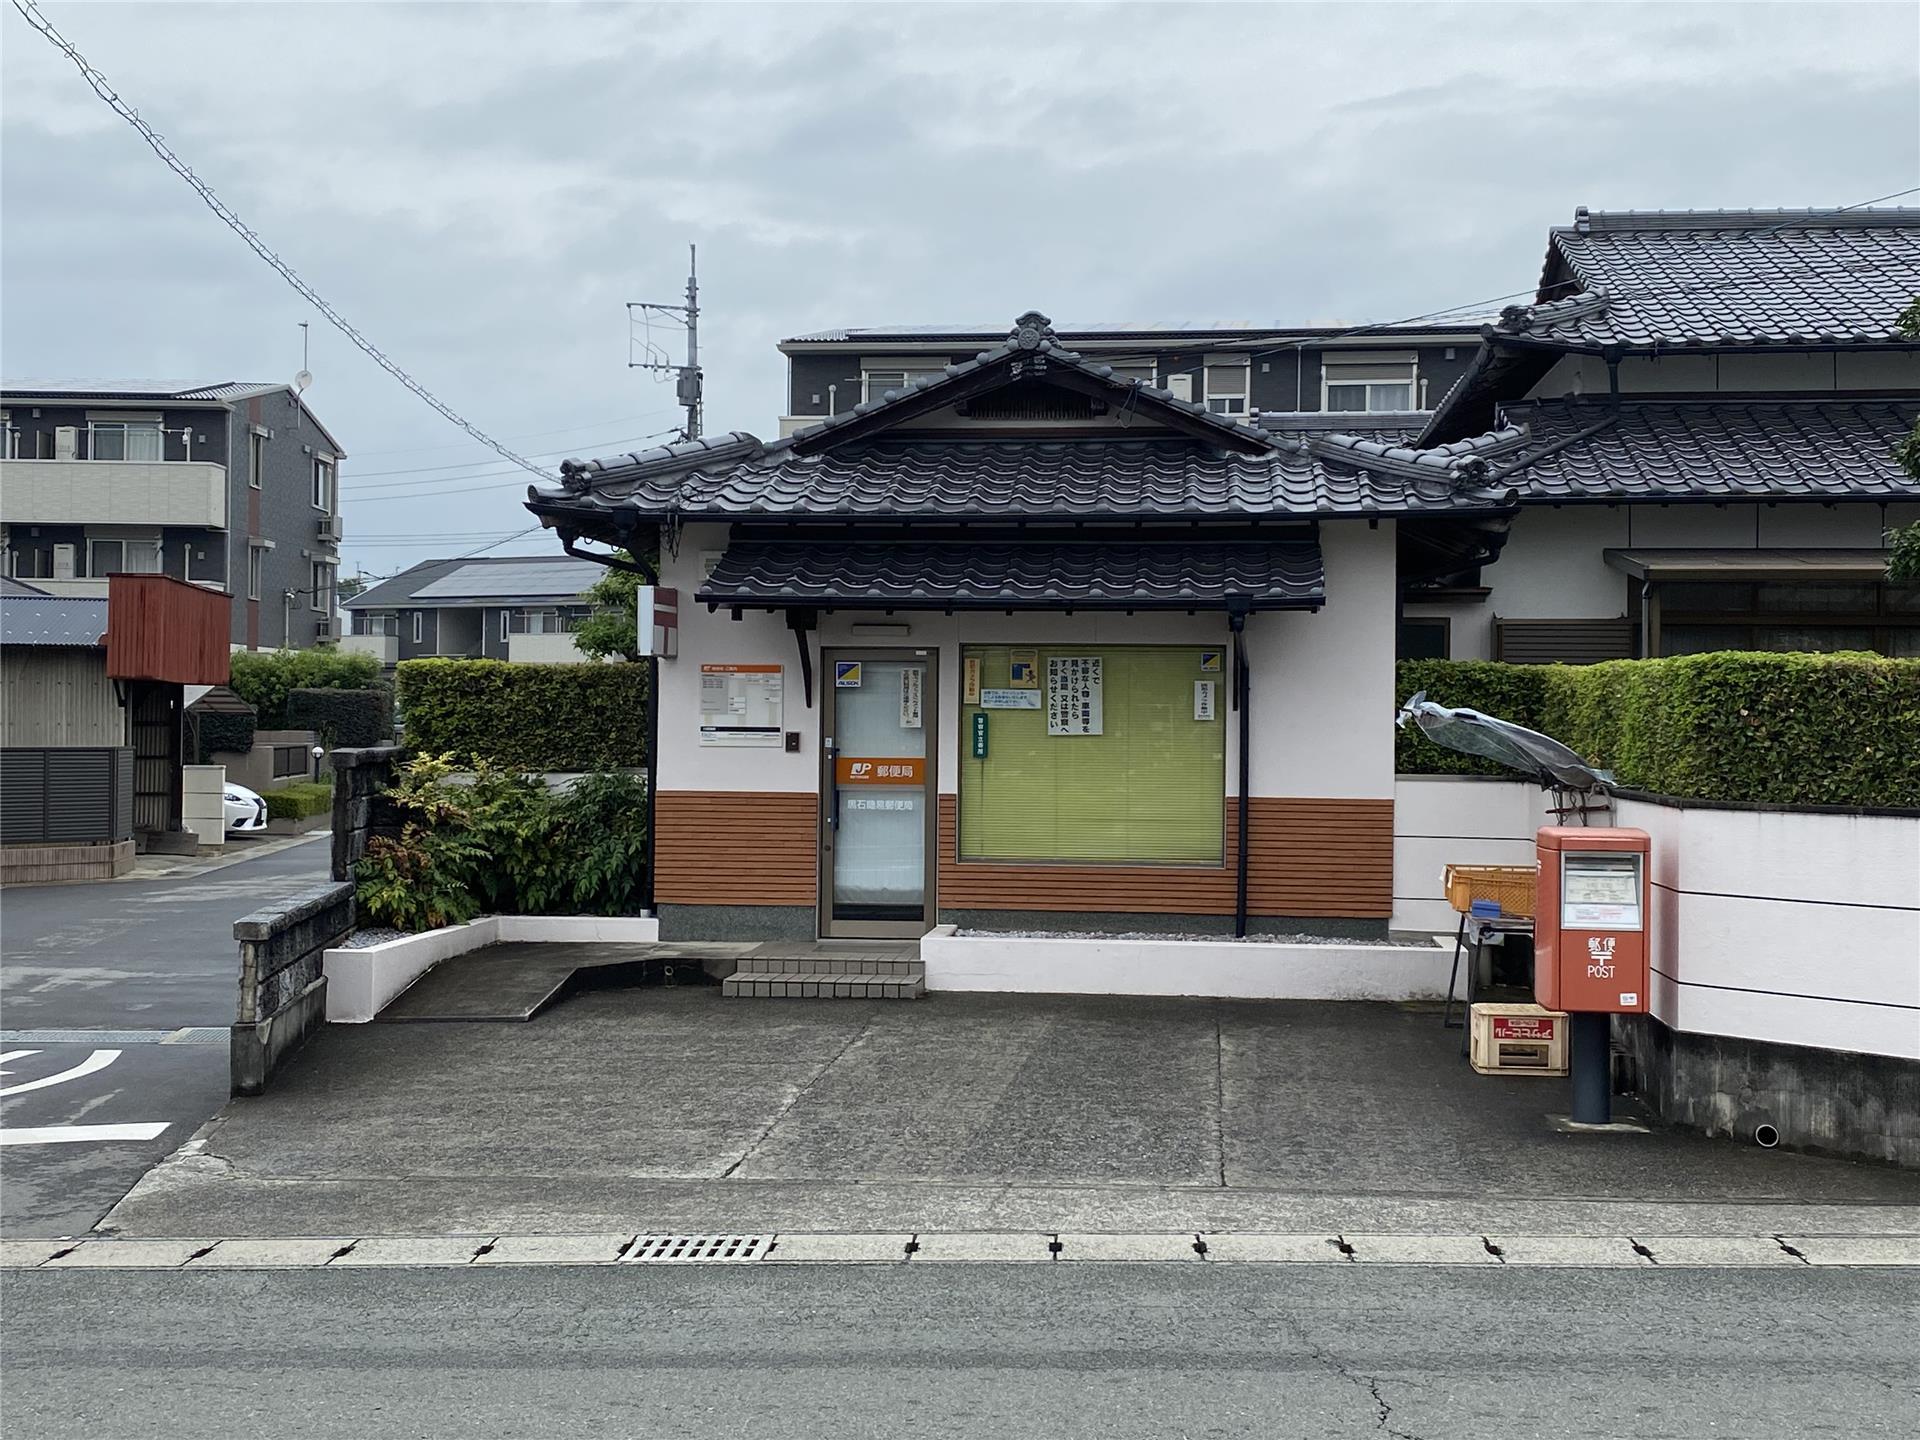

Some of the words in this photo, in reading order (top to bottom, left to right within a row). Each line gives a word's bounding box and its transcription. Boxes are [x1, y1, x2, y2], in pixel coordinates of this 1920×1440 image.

[1092, 659, 1100, 685] 近くで
[1049, 660, 1059, 728] お知らせください
[1071, 660, 1080, 719] 見かけられたら
[877, 765, 913, 778] 郵便局
[1588, 937, 1616, 952] 郵便
[1588, 965, 1615, 978] POST
[1495, 1028, 1553, 1039] アサヒビール
